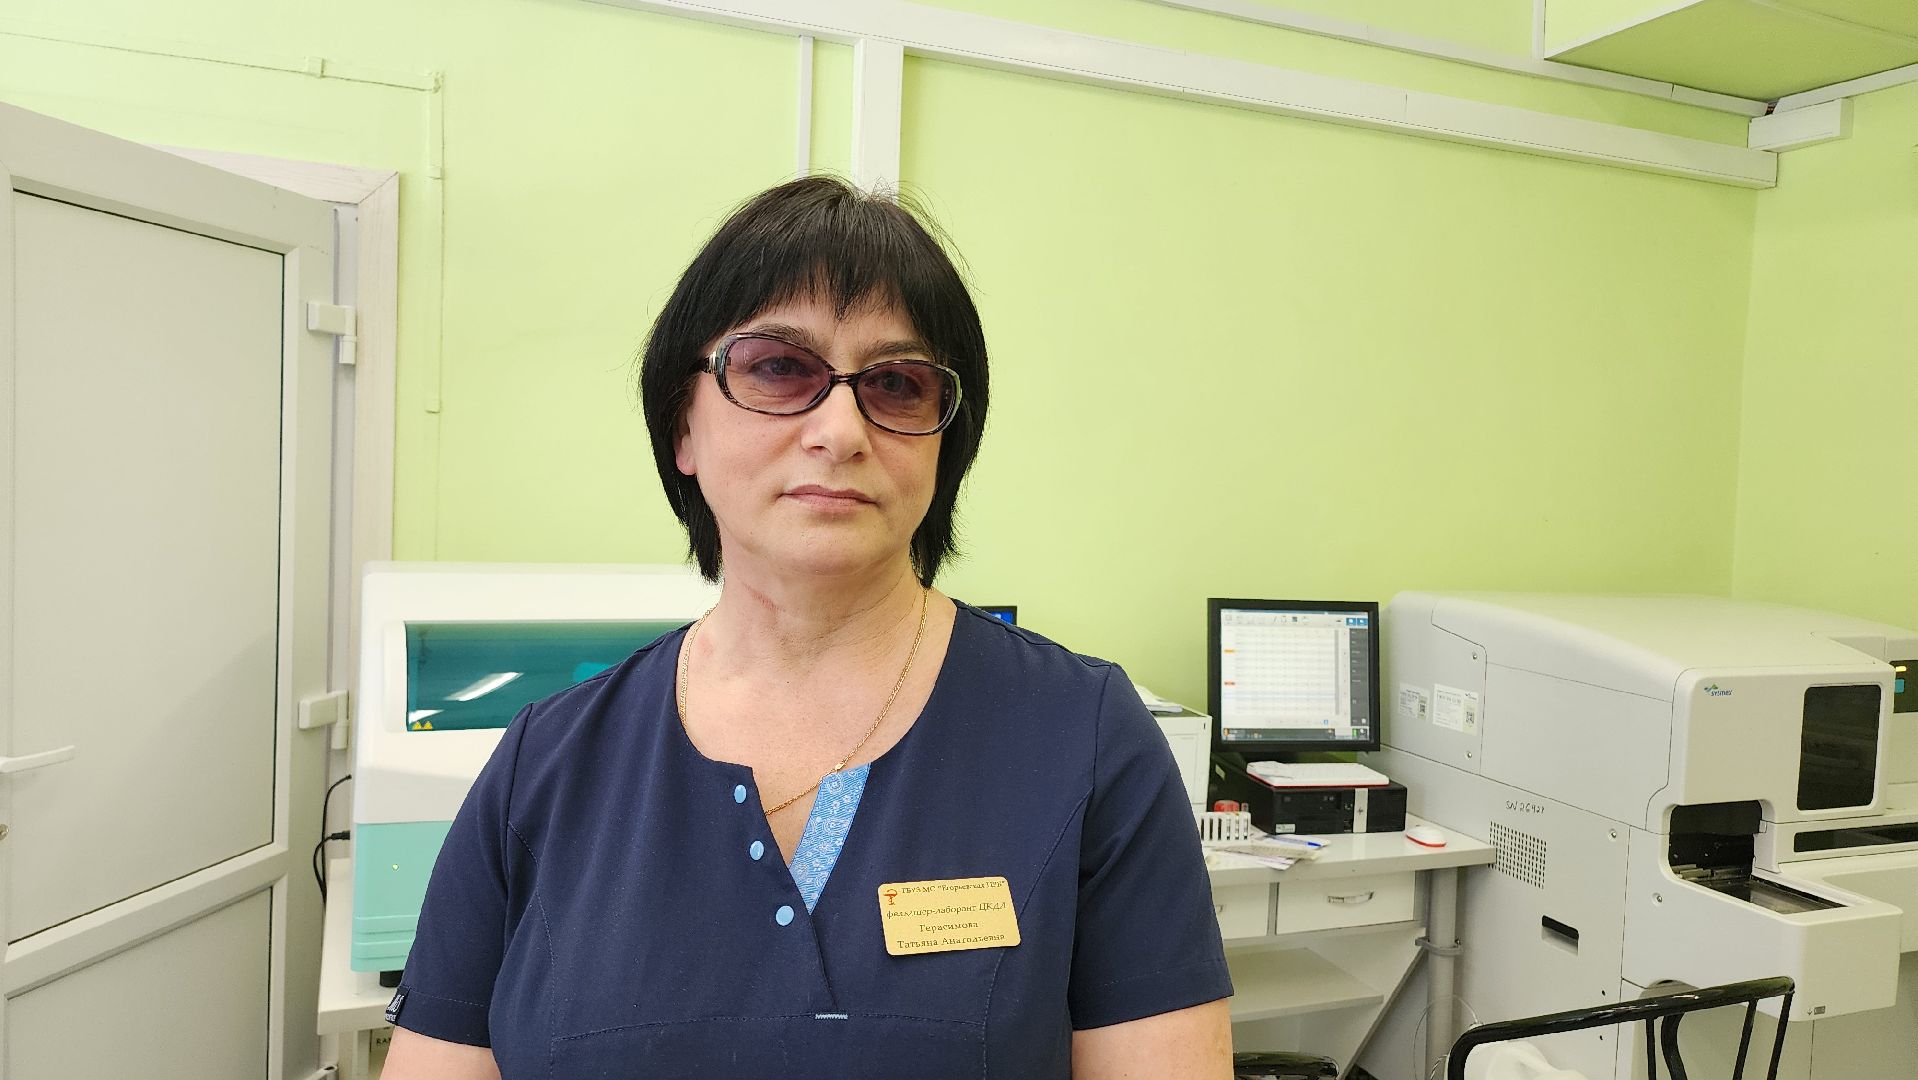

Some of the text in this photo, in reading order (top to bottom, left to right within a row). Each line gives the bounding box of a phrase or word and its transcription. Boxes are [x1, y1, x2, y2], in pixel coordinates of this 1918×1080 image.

[1505, 800, 1517, 811] SN
[919, 921, 979, 933] Герасимова
[897, 934, 1006, 949] Татьяна Анатольевна
